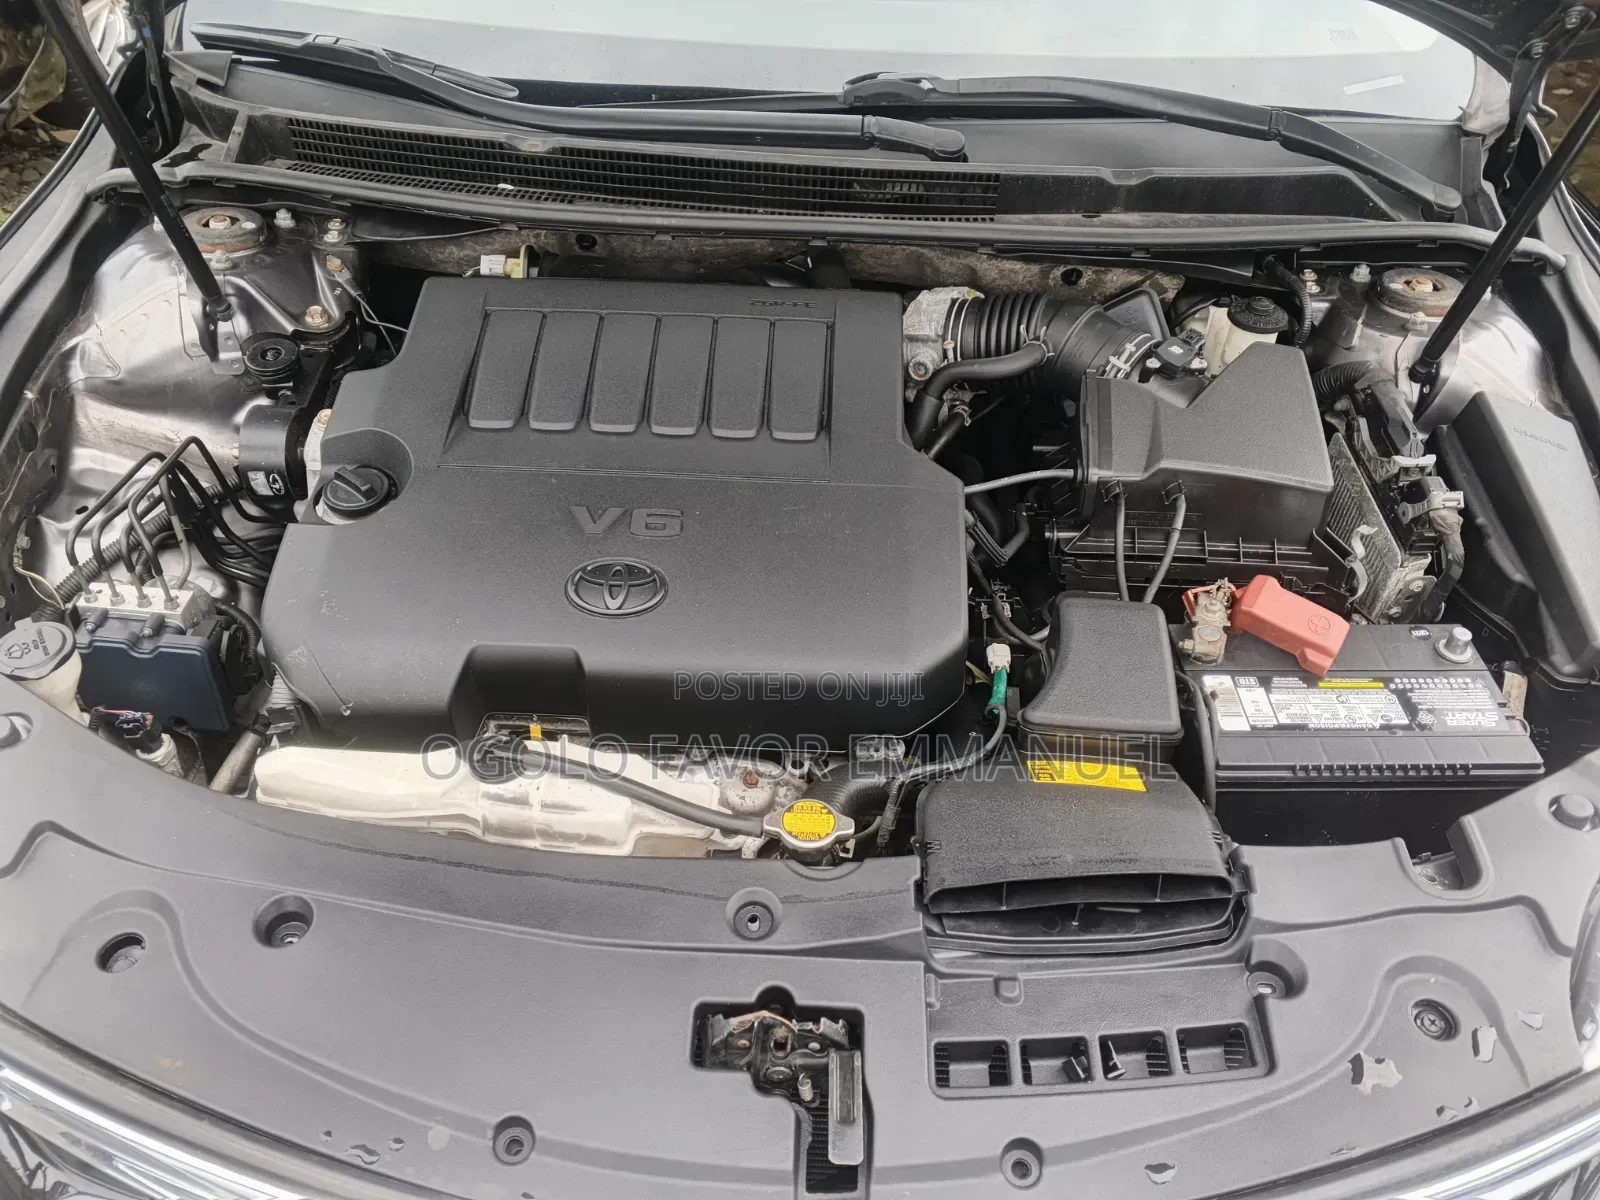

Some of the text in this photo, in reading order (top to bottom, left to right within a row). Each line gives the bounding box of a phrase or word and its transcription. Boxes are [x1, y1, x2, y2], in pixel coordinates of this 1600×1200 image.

[567, 504, 684, 538] V6
[1444, 711, 1499, 720] START
[1446, 719, 1496, 727] SUPER
